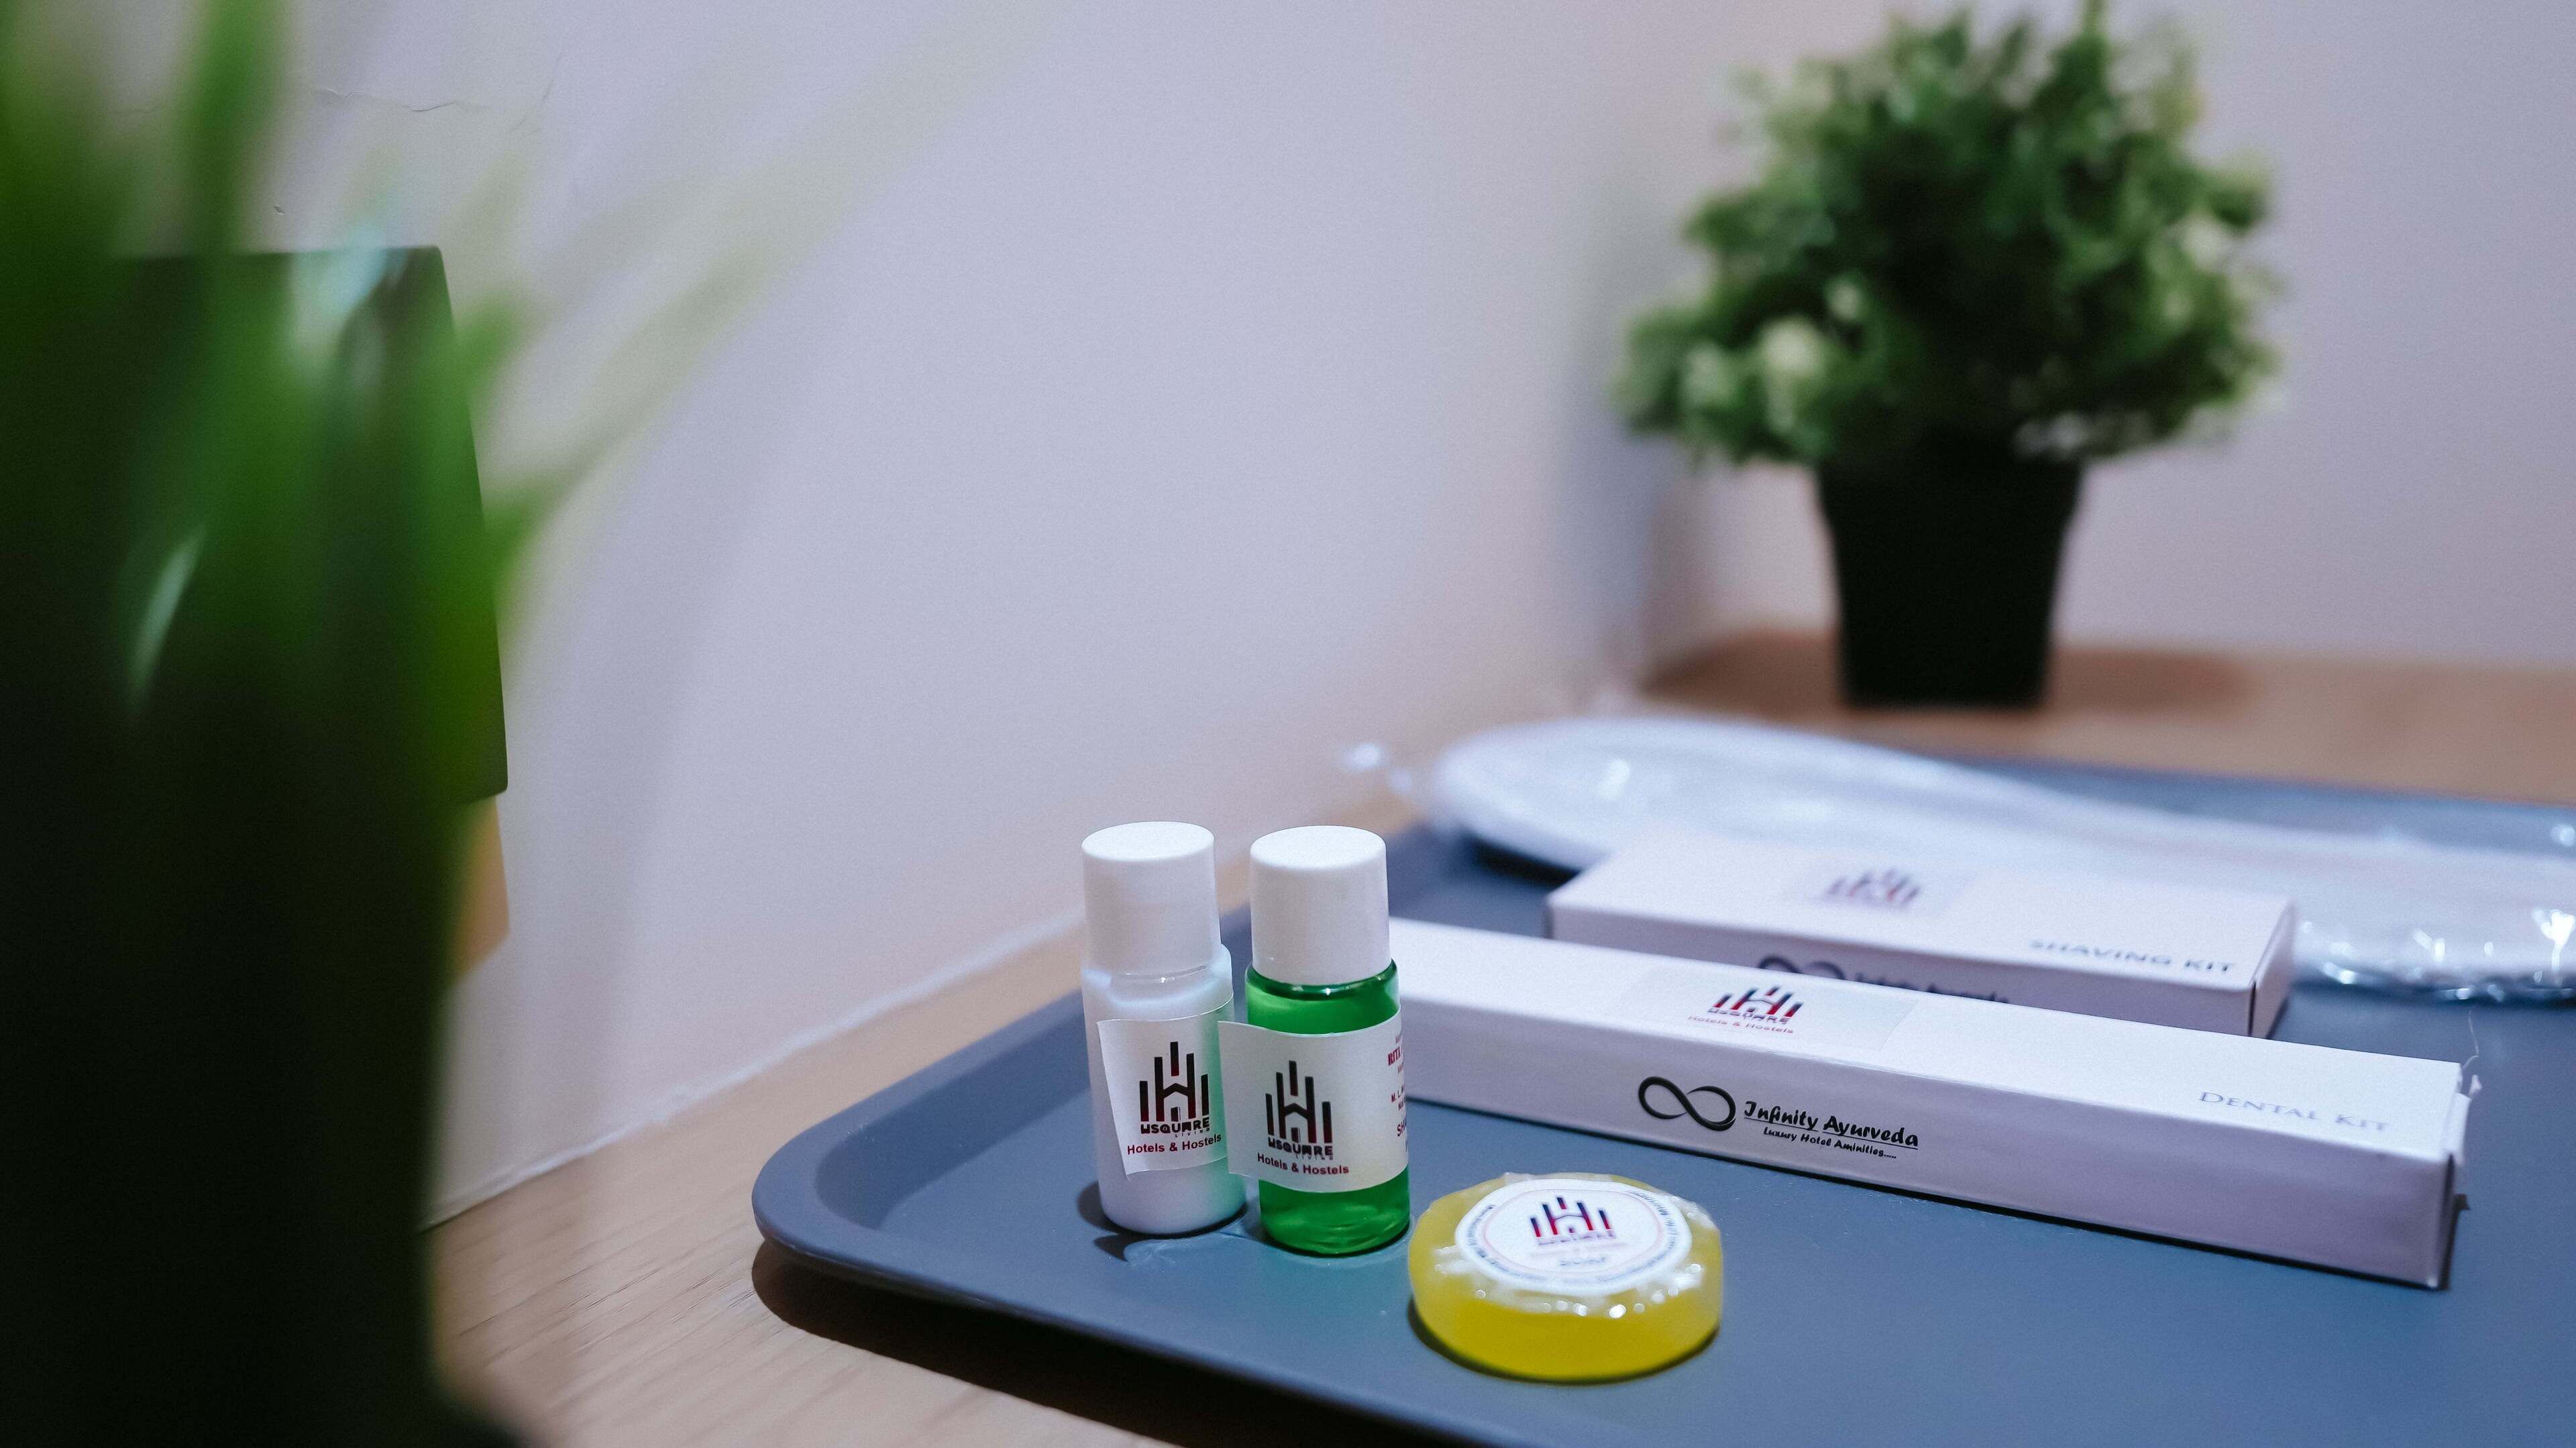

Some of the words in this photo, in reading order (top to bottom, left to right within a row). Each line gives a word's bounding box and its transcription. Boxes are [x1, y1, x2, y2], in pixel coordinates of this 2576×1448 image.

[2030, 939, 2171, 965] SHAVING
[2184, 959, 2237, 972] KIT
[1688, 1015, 1728, 1025] Hotels
[1746, 1023, 1794, 1034] Hostels
[2199, 1091, 2319, 1121] DENTAL
[2335, 1114, 2390, 1132] KIT
[1744, 1100, 1819, 1131] Infinity
[1823, 1115, 1919, 1147] Ayurveda
[1127, 1143, 1165, 1155] Hotels
[1169, 1142, 1178, 1152] &
[1182, 1133, 1222, 1151] Hostels
[1763, 1127, 1797, 1141] Luxury
[1801, 1133, 1831, 1147] Hotel
[1257, 1152, 1288, 1170] Hotels
[1291, 1162, 1299, 1173] &
[1303, 1165, 1350, 1175] Hostels
